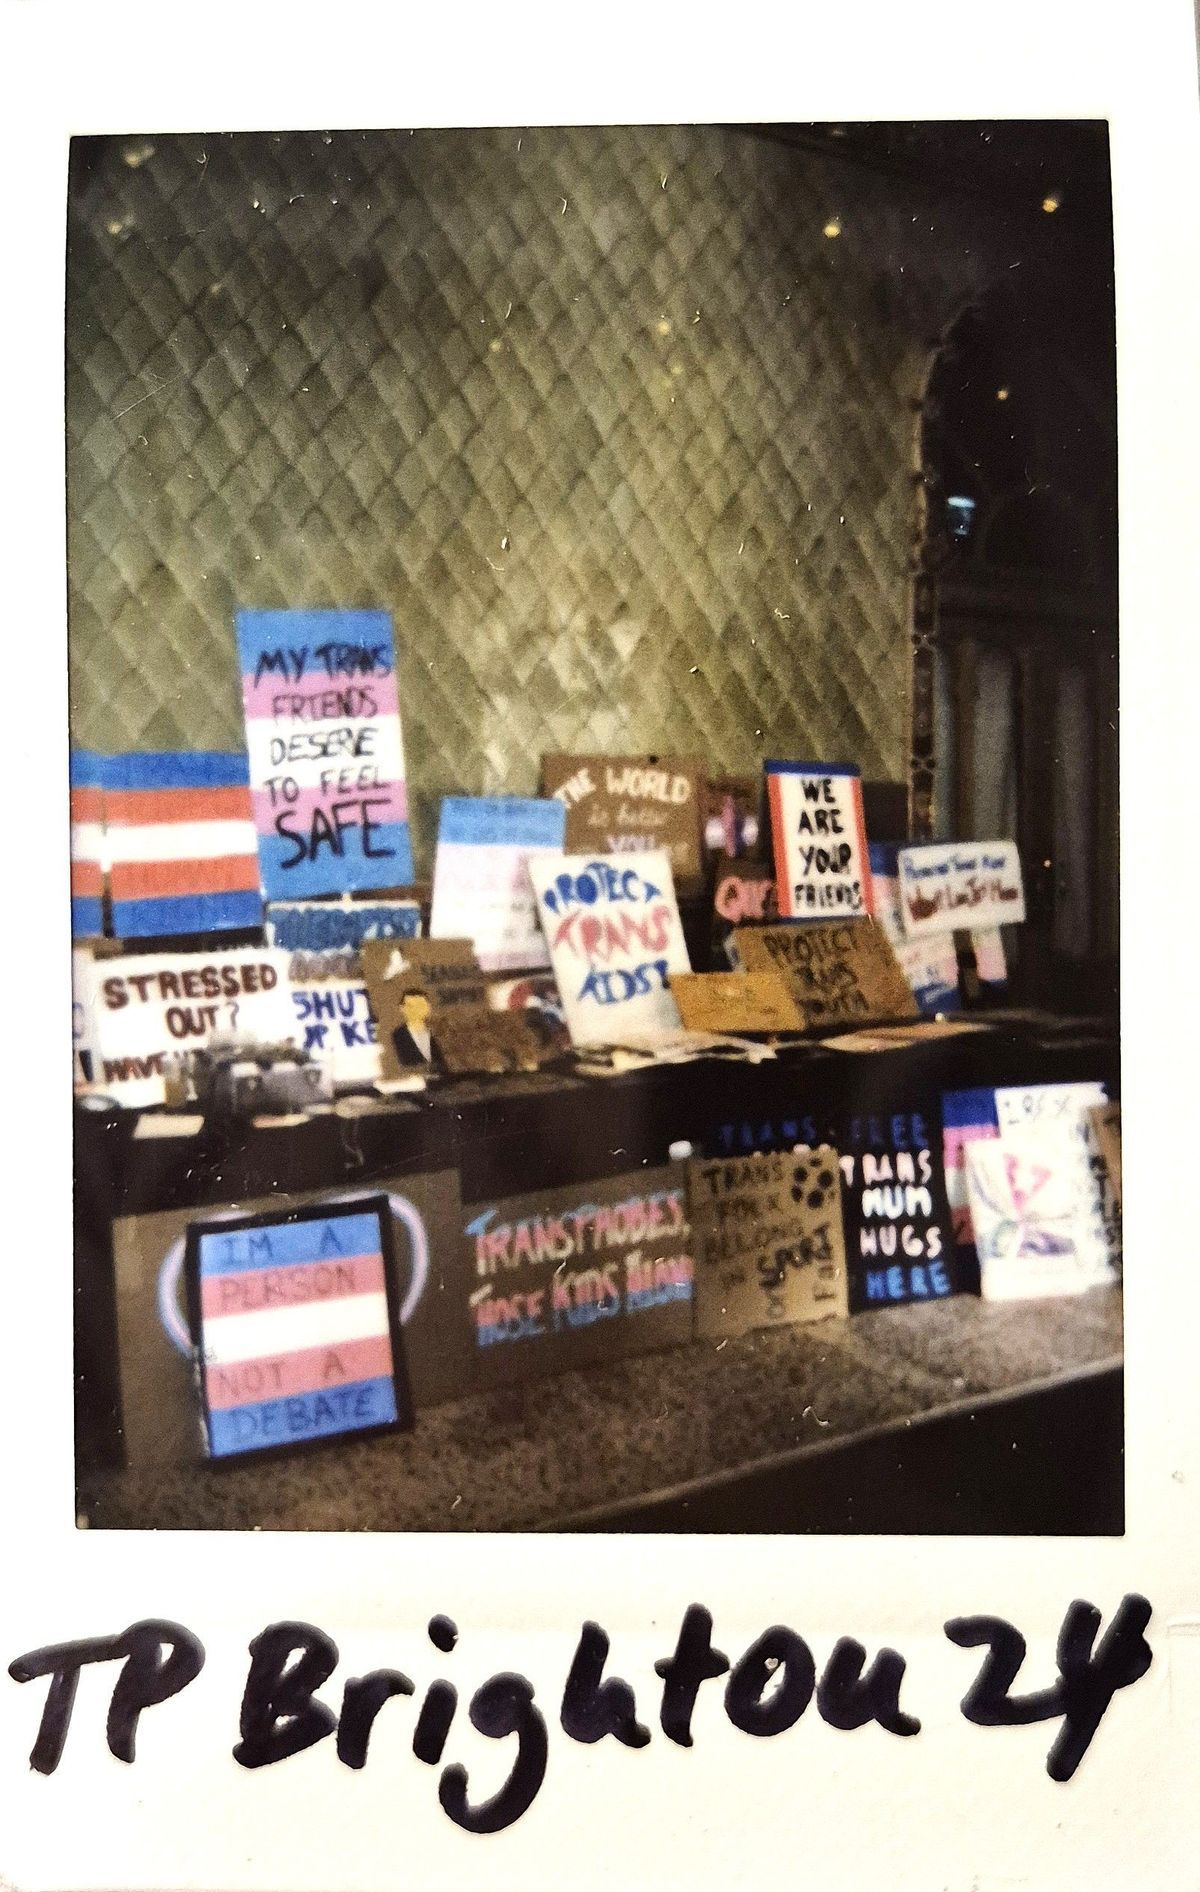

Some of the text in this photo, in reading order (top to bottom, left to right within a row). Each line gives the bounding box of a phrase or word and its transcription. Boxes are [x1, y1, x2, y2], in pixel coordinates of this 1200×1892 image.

[254, 641, 391, 688] MY TRANS
[272, 686, 379, 723] FRIENDS
[265, 765, 390, 806] TO FEEL
[606, 766, 692, 804] WORLD
[801, 778, 836, 803] WE
[274, 799, 396, 869] SAFE
[797, 809, 844, 836] ARE
[799, 842, 852, 875] YOUR
[544, 862, 662, 913] PROTECT
[794, 881, 862, 910] FRIENDS
[552, 905, 671, 960] TRANS
[103, 964, 278, 1010] STRESSED
[291, 988, 378, 1024] SHUT
[702, 1158, 784, 1195] TRANS
[838, 1148, 932, 1187] TRANS
[861, 1186, 932, 1219] MUM
[319, 1224, 344, 1254] A
[859, 1225, 942, 1259] HUGS
[219, 1263, 356, 1308] PERSON
[865, 1259, 951, 1299] HERE
[217, 1349, 346, 1398] NOT A
[230, 1385, 375, 1436] DEBATE
[7, 1593, 1153, 1834] TP Brighton 24
